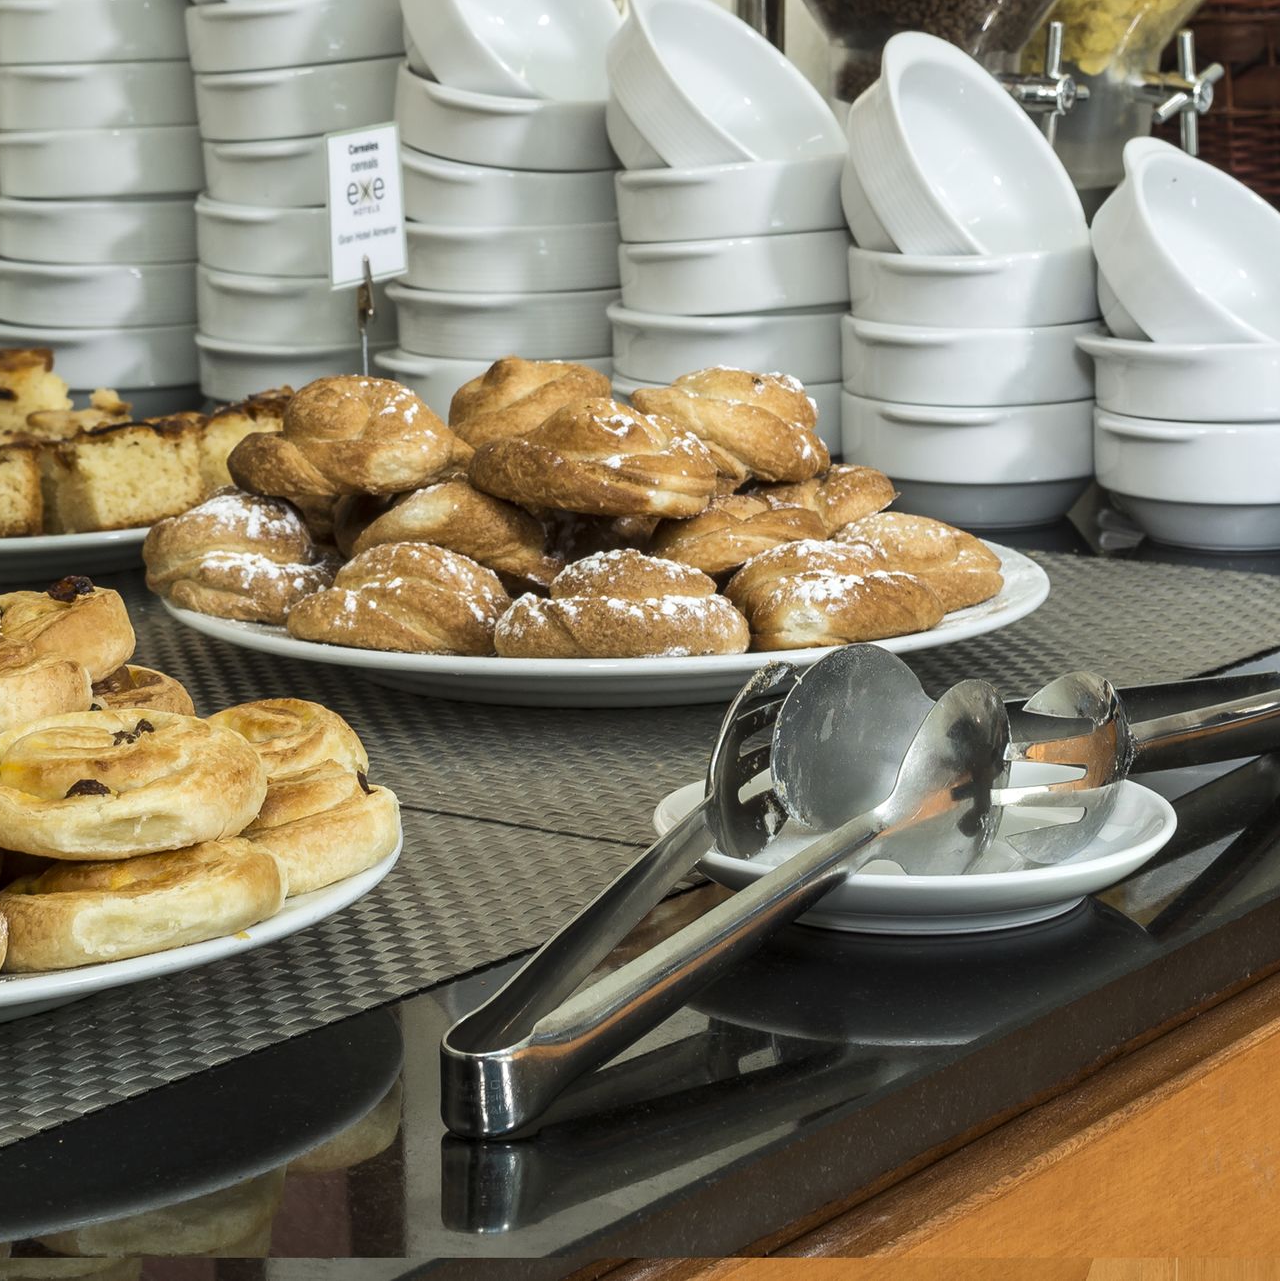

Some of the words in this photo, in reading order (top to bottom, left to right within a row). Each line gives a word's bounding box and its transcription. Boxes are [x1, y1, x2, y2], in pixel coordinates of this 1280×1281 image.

[348, 142, 379, 155] Cereales
[351, 158, 379, 173] cereals
[346, 177, 385, 206] exe
